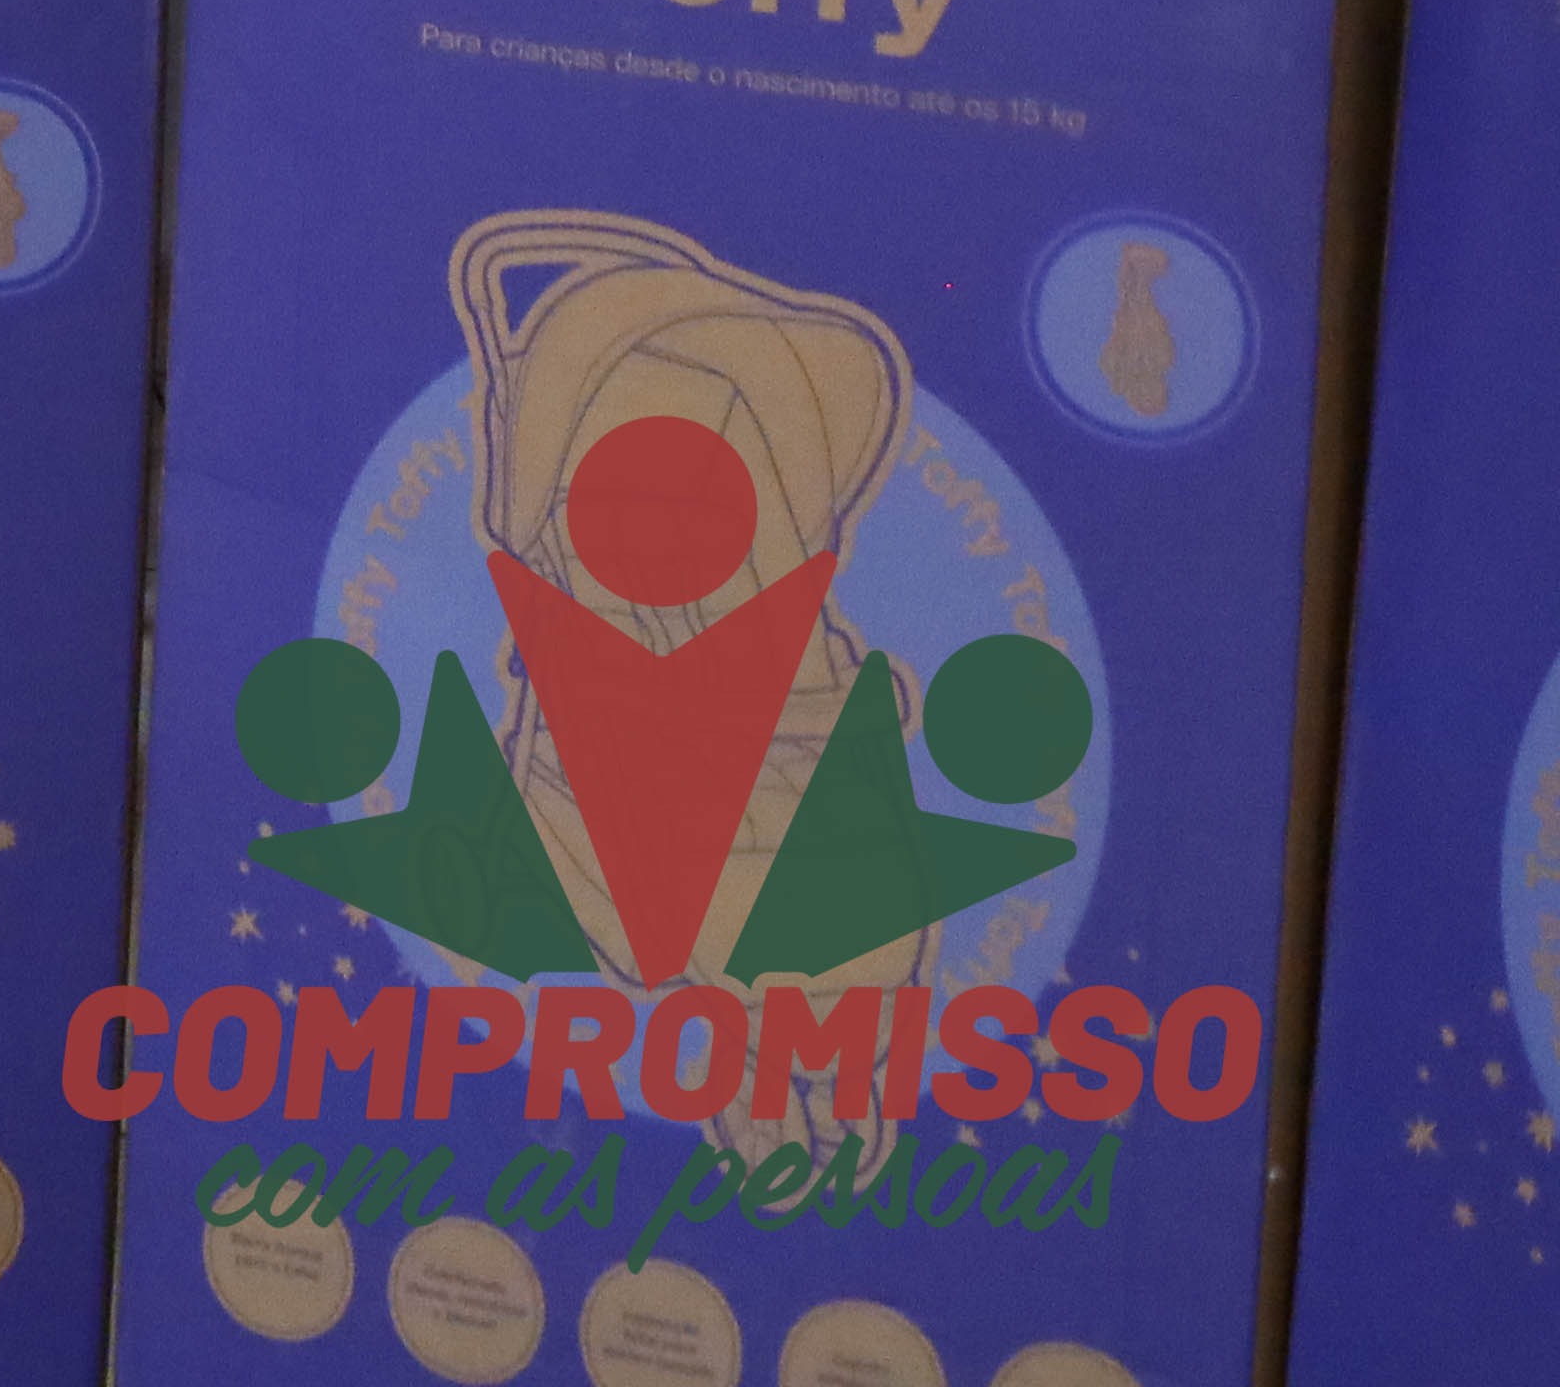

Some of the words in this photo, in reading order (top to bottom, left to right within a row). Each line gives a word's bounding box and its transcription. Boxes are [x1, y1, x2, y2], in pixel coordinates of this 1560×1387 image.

[422, 24, 482, 55] Para
[491, 36, 606, 73] crianças
[615, 49, 700, 83] desde
[735, 69, 900, 108] nascimento
[908, 87, 956, 116] até
[366, 429, 466, 541] Toffy
[904, 427, 1009, 557] Toffy
